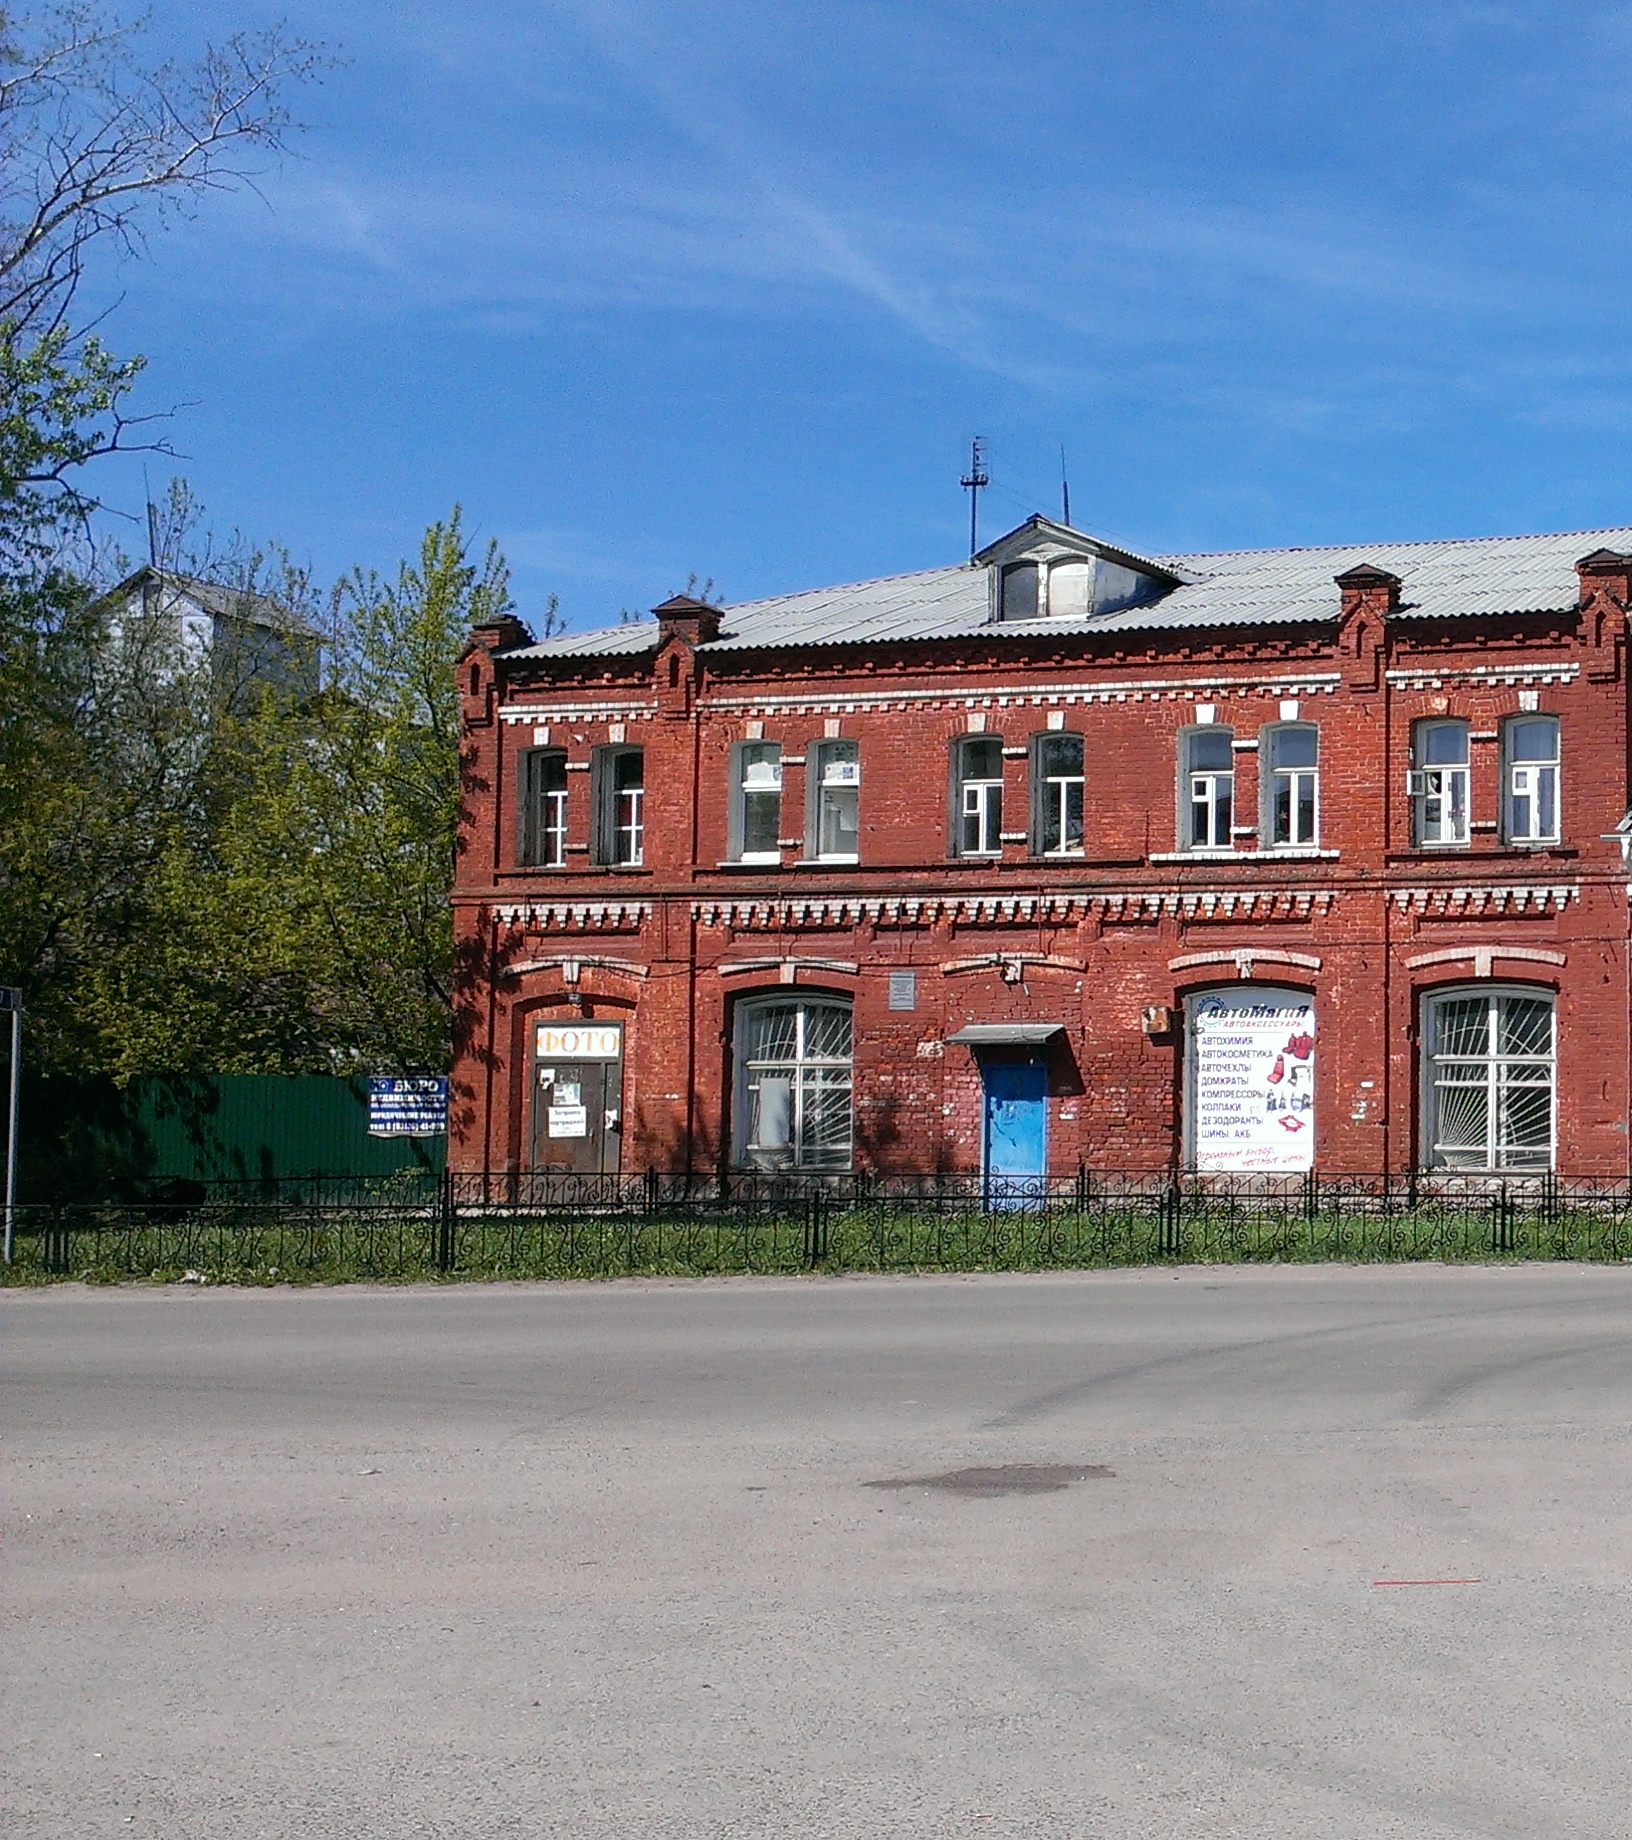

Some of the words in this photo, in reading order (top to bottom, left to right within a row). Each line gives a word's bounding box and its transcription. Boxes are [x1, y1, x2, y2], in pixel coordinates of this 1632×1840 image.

[1222, 1020, 1305, 1028] АВТОАКСЕССУАРЫ
[537, 1030, 619, 1053] ФОТО
[1201, 1036, 1254, 1045] АВТОХИМИЯ
[1201, 1049, 1274, 1059] АВТОКОСМЕТИКА
[1201, 1063, 1252, 1073] АВТОЧЕХЛЫ
[393, 1079, 439, 1093] БЮРО
[1201, 1076, 1249, 1086] ДОМКРАТЫ
[1201, 1089, 1266, 1099] КОМПРЕССОРЫ
[1201, 1103, 1242, 1112] КОЛПАКИ
[1201, 1116, 1264, 1126] ДЕЗОДОРАНТЫ
[1234, 1129, 1251, 1139] АКБ
